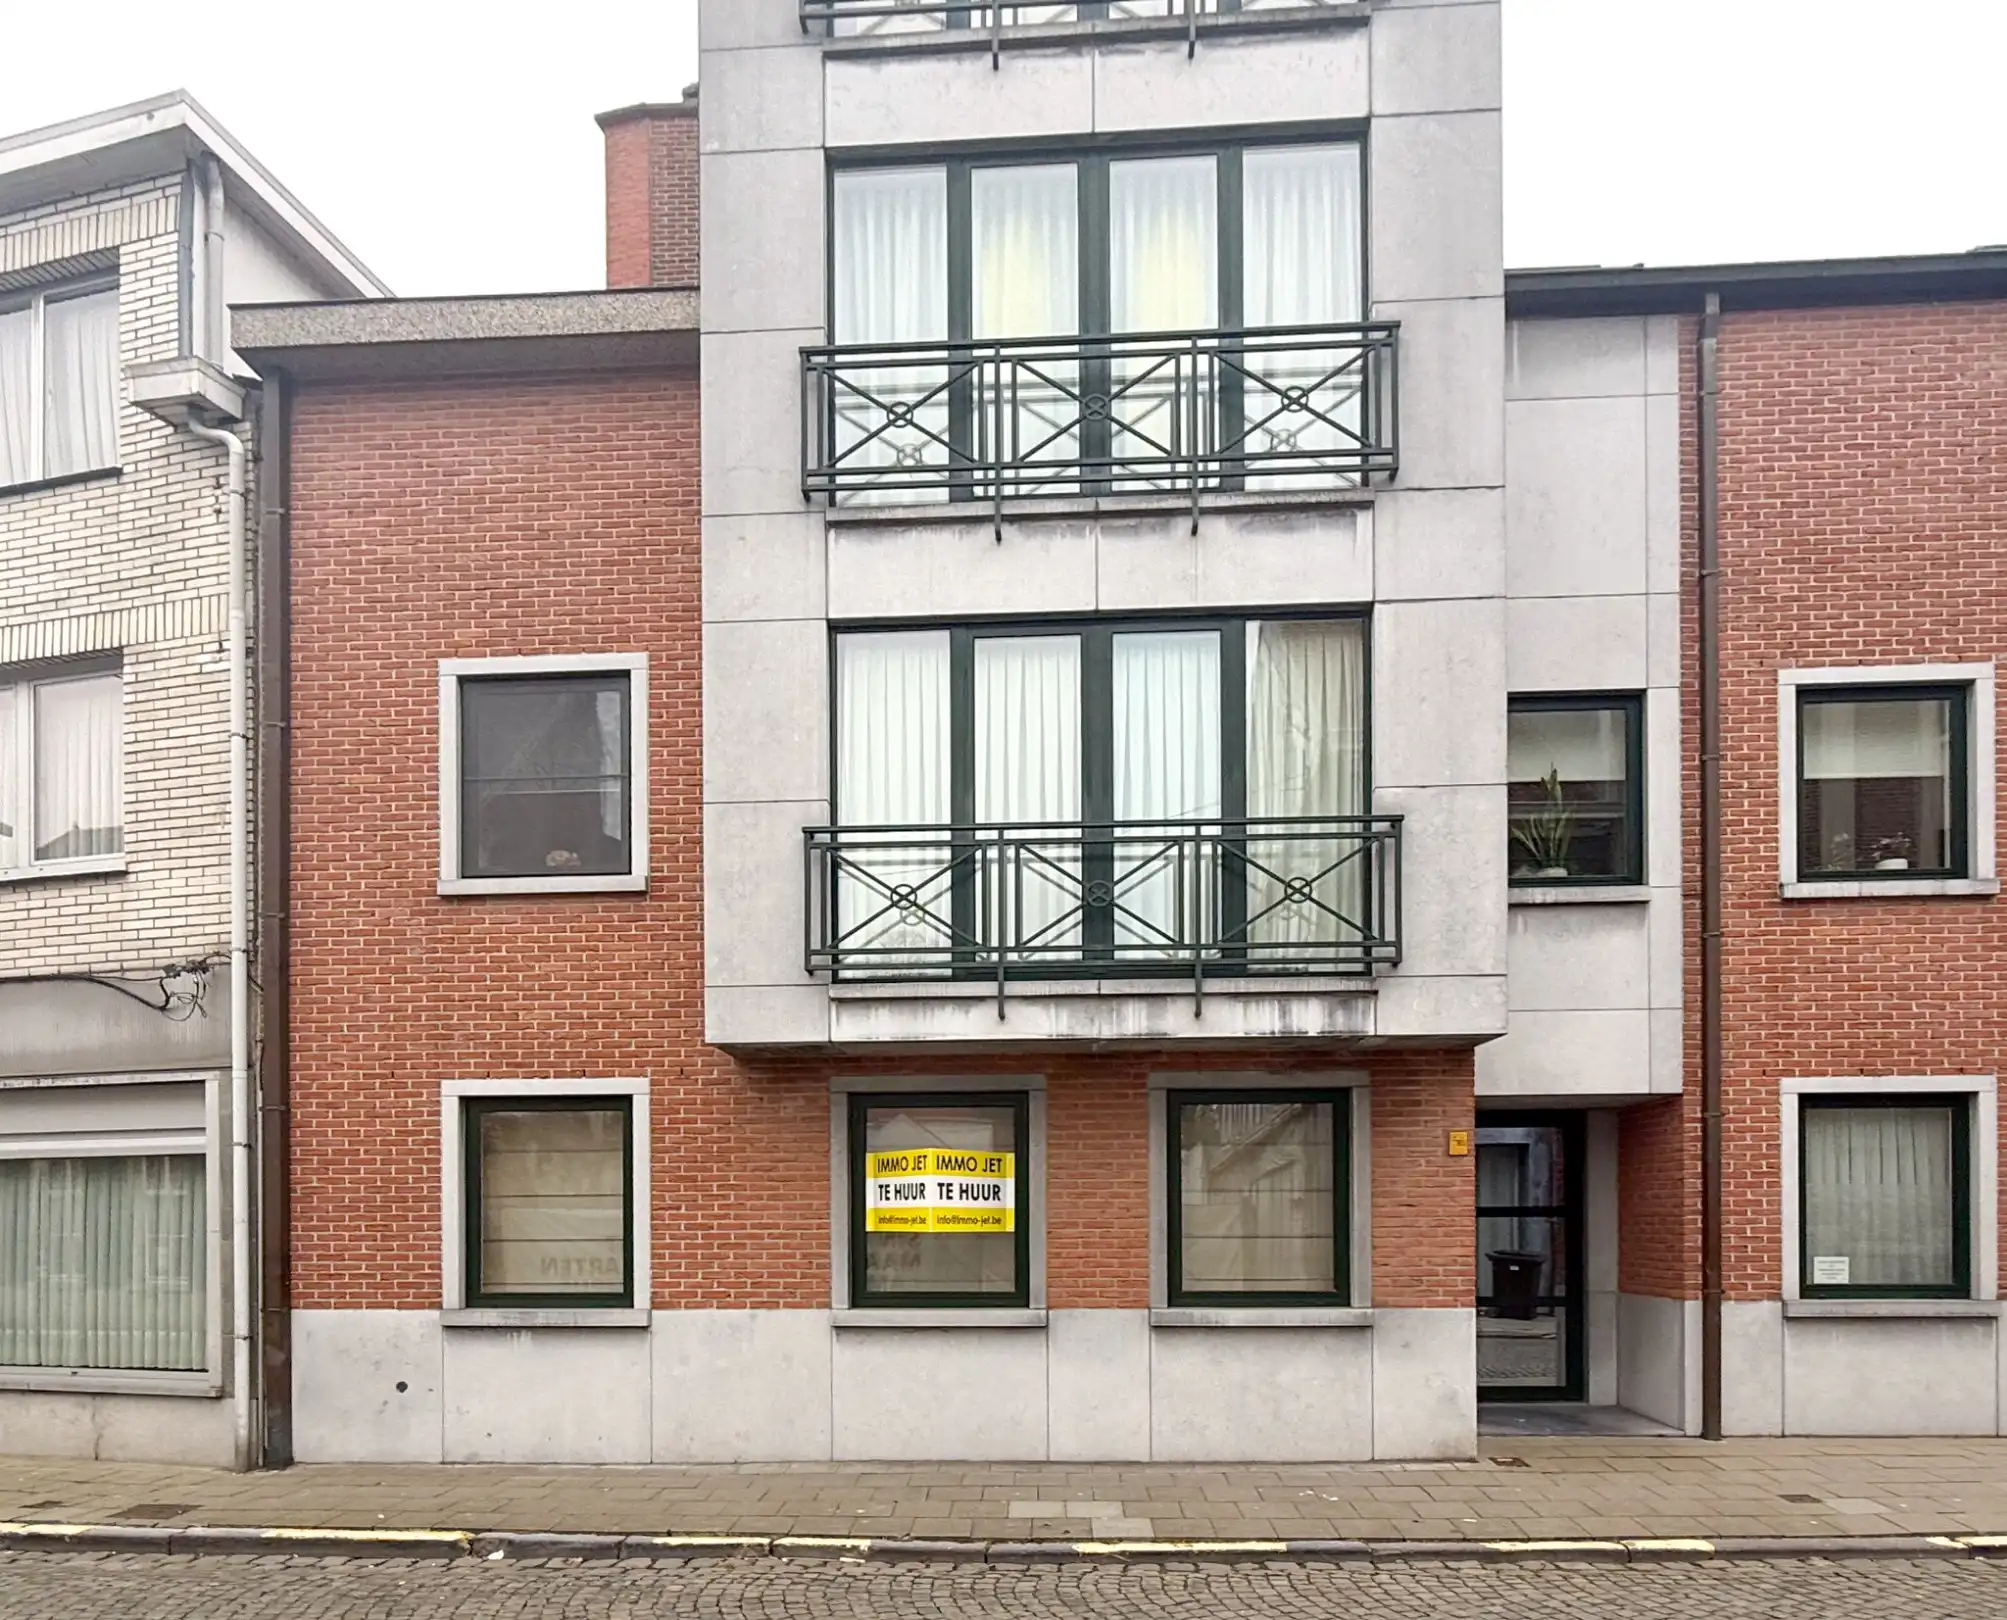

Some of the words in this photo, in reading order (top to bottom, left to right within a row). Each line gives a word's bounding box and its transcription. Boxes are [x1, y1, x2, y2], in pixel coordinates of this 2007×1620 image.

[877, 1155, 909, 1173] IMMO
[911, 1155, 928, 1171] JET
[936, 1155, 978, 1172] IMMO
[982, 1158, 1003, 1173] JET
[878, 1184, 891, 1201] TE
[894, 1183, 926, 1201] HUUR
[937, 1183, 954, 1200] TE
[959, 1183, 1001, 1201] HUUR
[877, 1215, 927, 1227] info@immo-jet.be
[936, 1215, 1002, 1227] info@immo-jet.be
